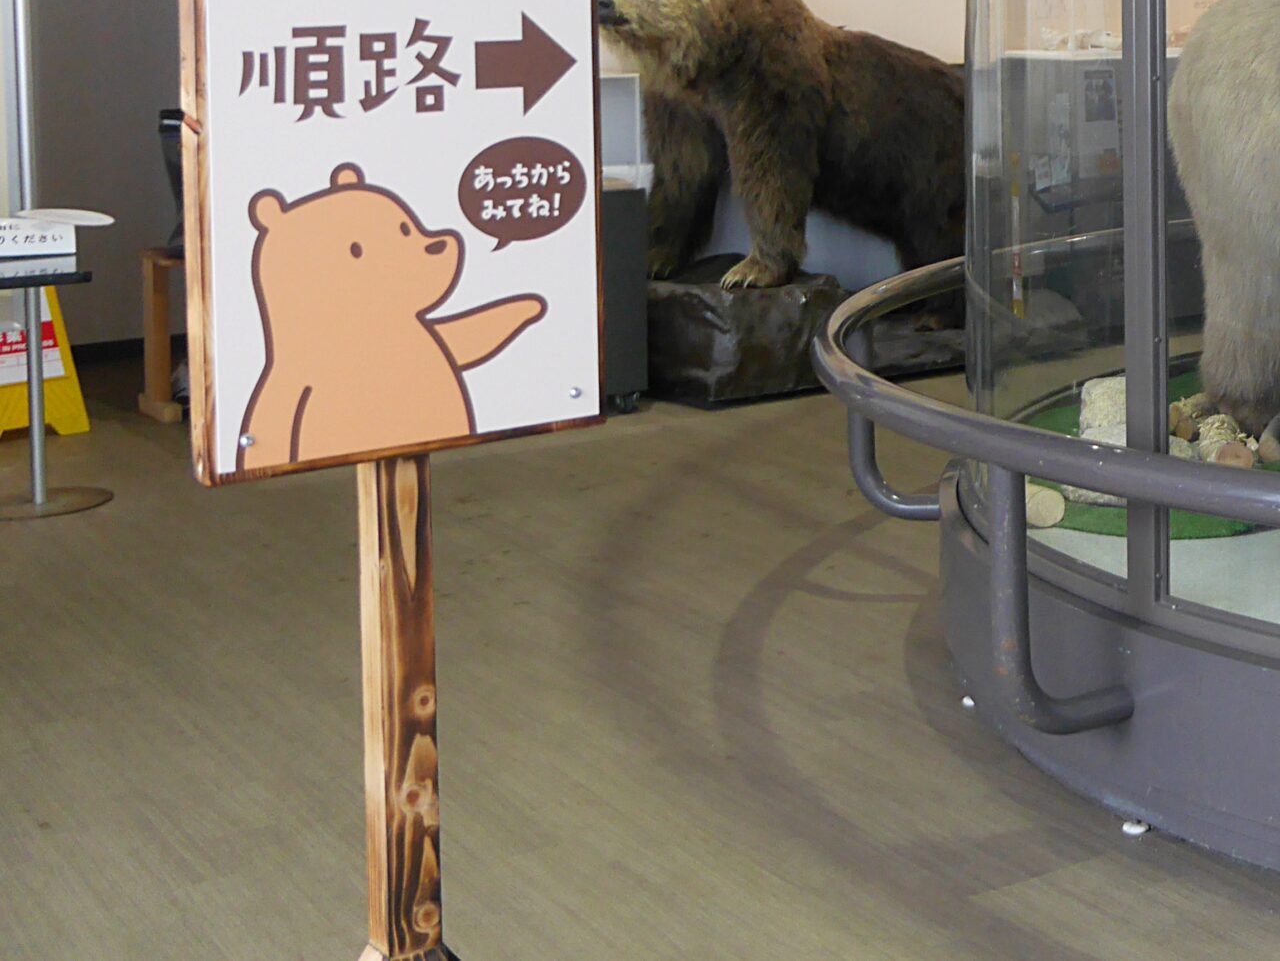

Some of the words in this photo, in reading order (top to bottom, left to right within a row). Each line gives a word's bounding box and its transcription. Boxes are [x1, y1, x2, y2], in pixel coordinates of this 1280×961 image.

[239, 18, 462, 122] 順路
[474, 160, 570, 191] あっちから
[481, 192, 561, 220] みてね!
